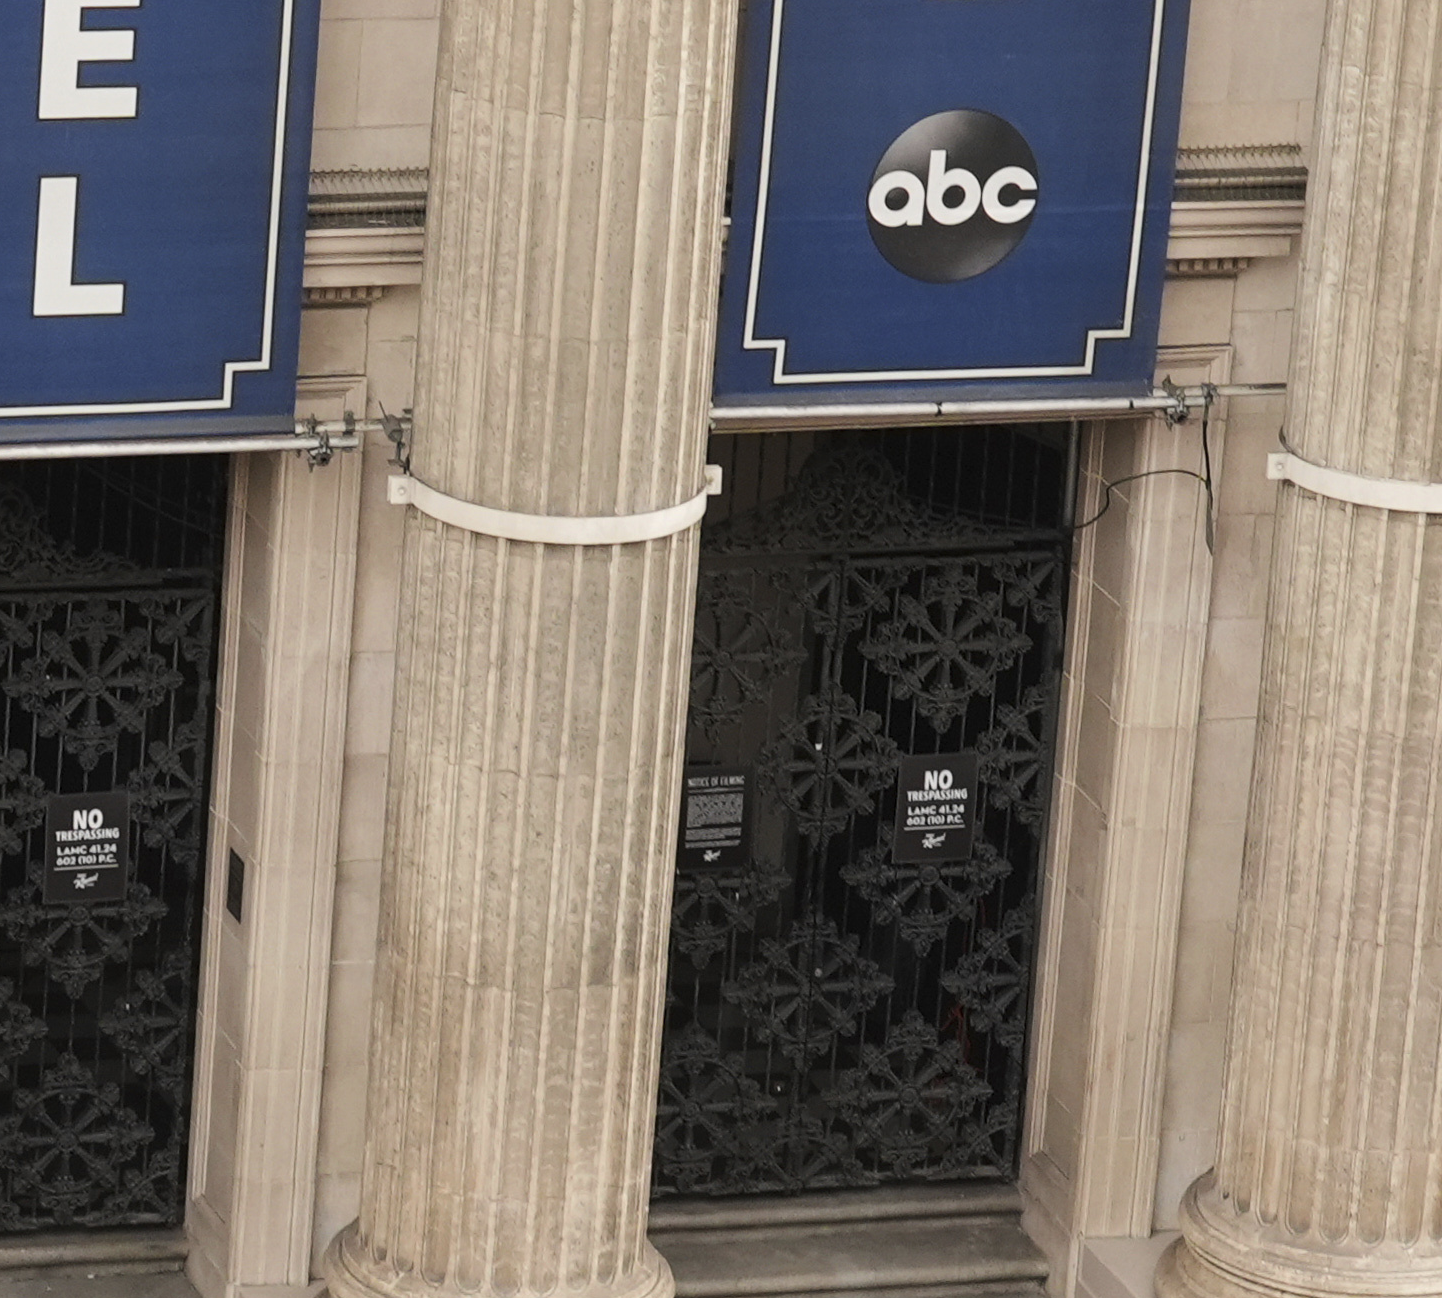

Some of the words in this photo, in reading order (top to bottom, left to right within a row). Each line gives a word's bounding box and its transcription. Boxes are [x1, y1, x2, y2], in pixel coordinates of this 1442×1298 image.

[868, 149, 1038, 228] abc
[924, 769, 954, 790] NO
[906, 787, 968, 802] TRESPASSING
[907, 805, 938, 816] LAMC
[72, 808, 104, 830] NO
[906, 816, 926, 826] 602
[55, 827, 120, 842] TRESPASSING
[56, 845, 88, 856] LAMC
[56, 856, 77, 866] 602
